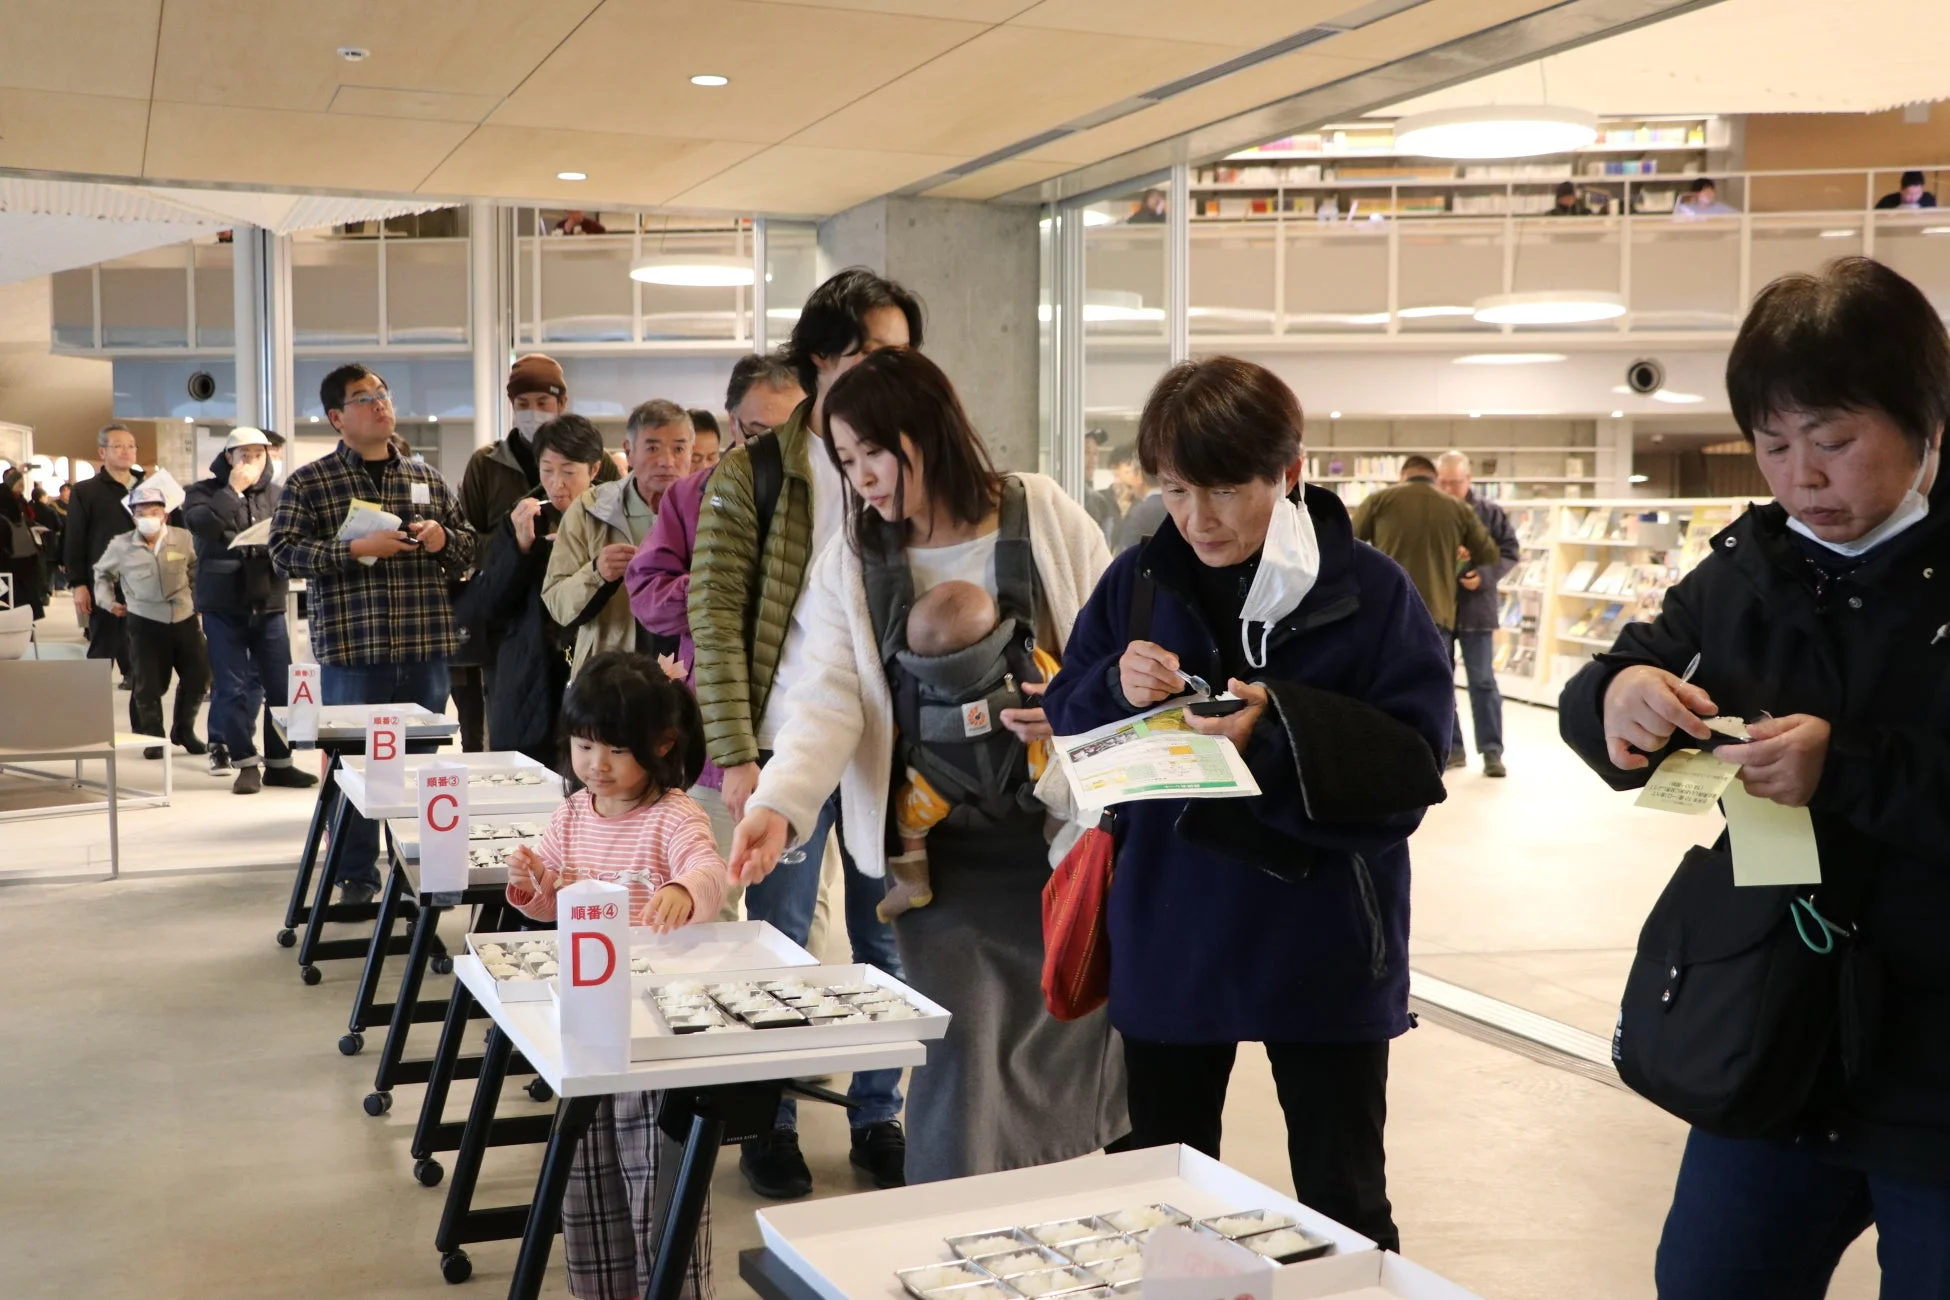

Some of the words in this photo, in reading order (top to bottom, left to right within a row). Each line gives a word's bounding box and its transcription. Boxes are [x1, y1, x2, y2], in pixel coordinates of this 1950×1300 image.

[293, 681, 313, 704] A
[372, 730, 397, 761] B
[426, 775, 459, 788] 順番③
[426, 794, 460, 832] C
[571, 903, 618, 920] 順番④
[571, 931, 616, 987] D
